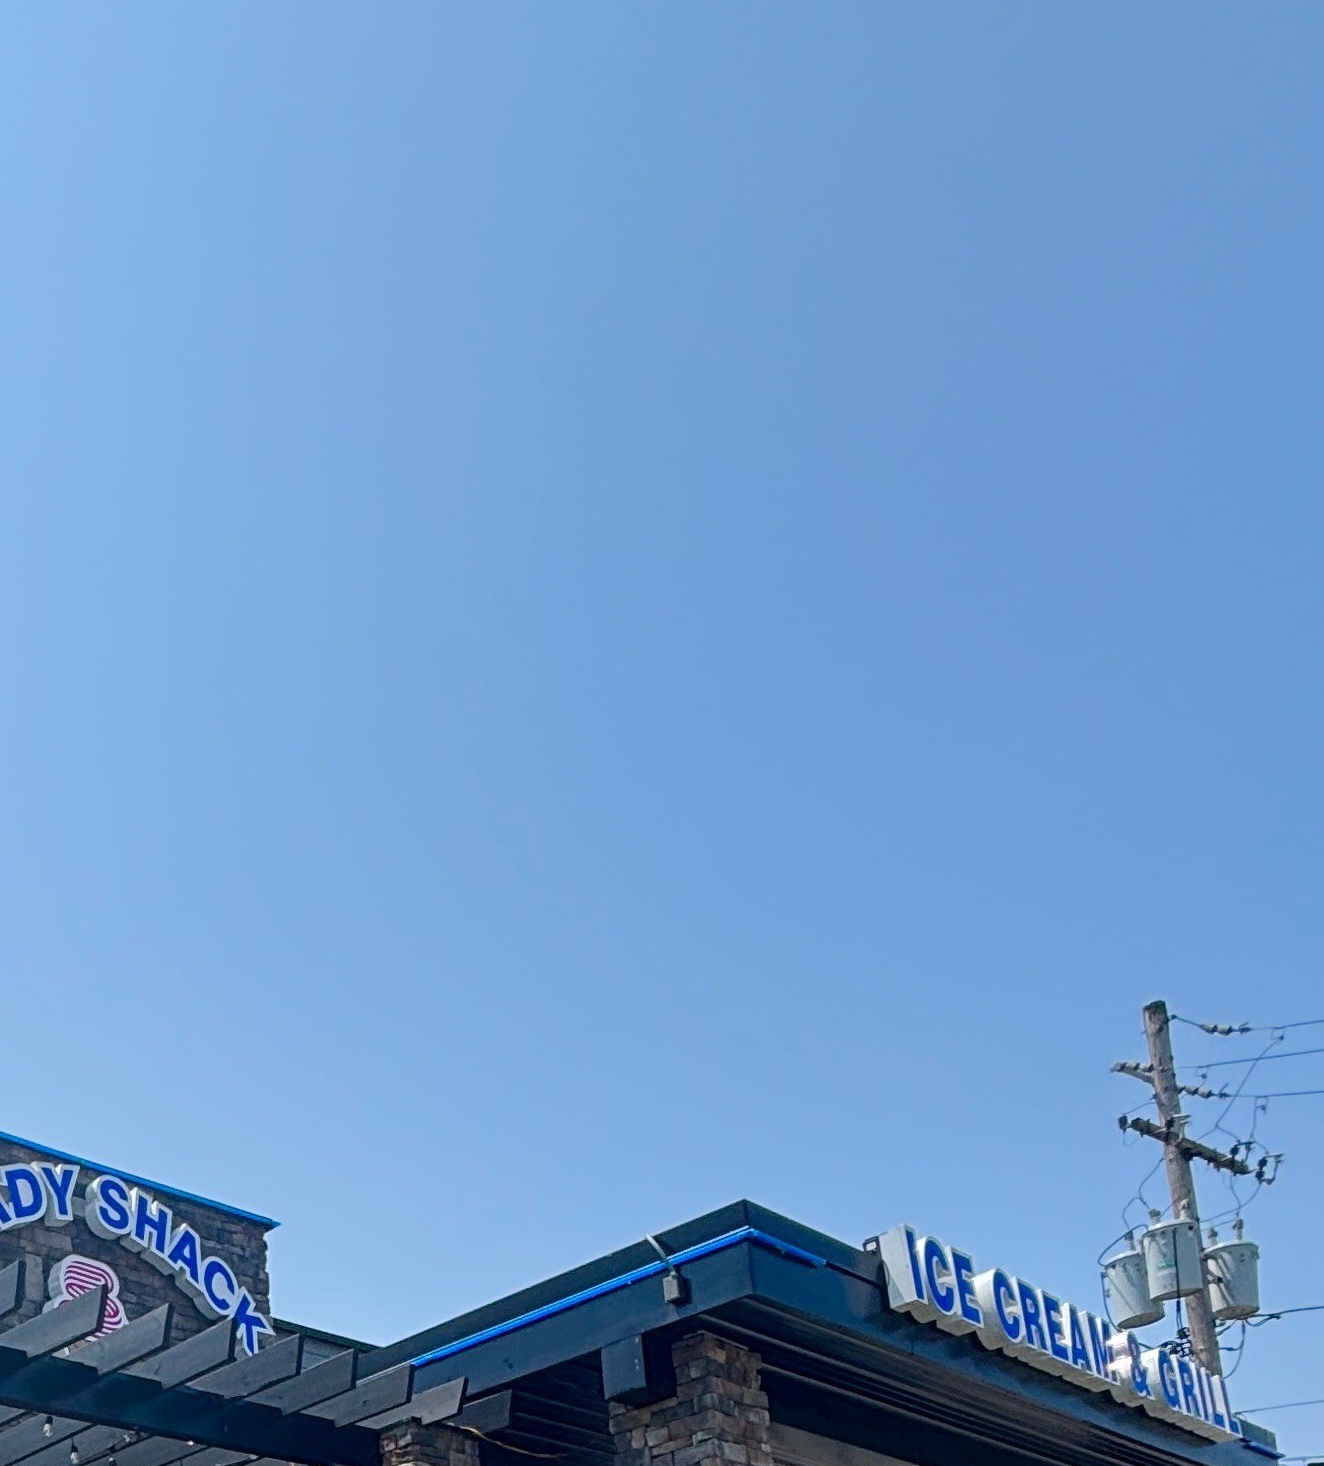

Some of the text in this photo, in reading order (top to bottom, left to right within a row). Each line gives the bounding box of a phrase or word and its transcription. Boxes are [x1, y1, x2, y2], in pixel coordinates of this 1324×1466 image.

[95, 1175, 277, 1356] SHACK
[905, 1226, 1242, 1437] ICE CREAM & GRILL
